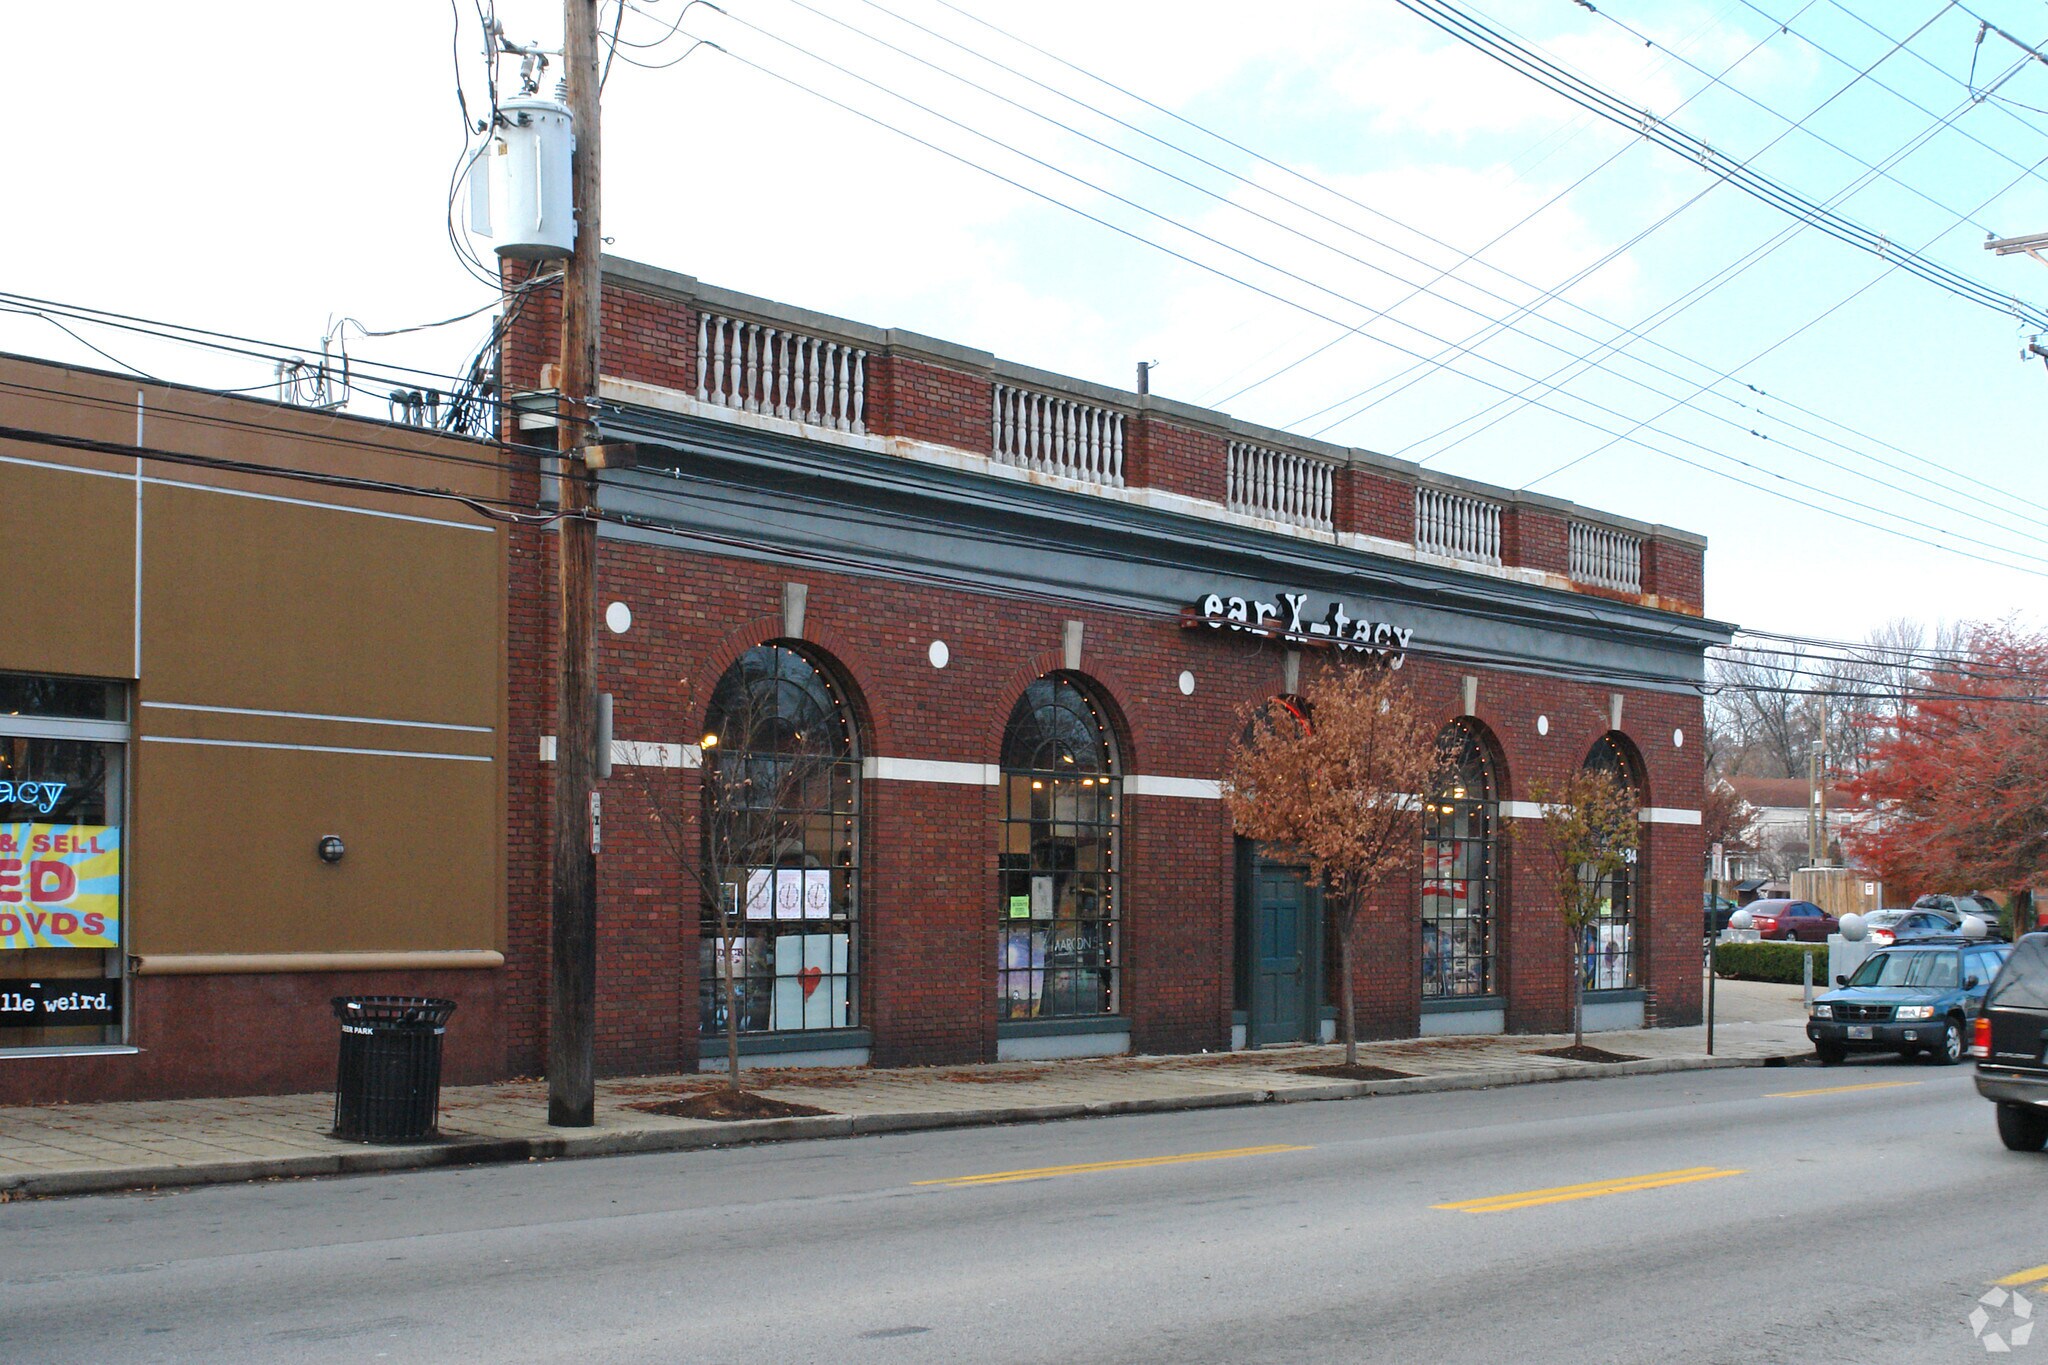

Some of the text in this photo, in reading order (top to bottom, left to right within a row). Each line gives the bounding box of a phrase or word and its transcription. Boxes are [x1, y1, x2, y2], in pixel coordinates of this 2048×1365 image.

[32, 834, 106, 854] SELL
[43, 991, 112, 1013] weird.
[354, 1026, 374, 1036] PARK
